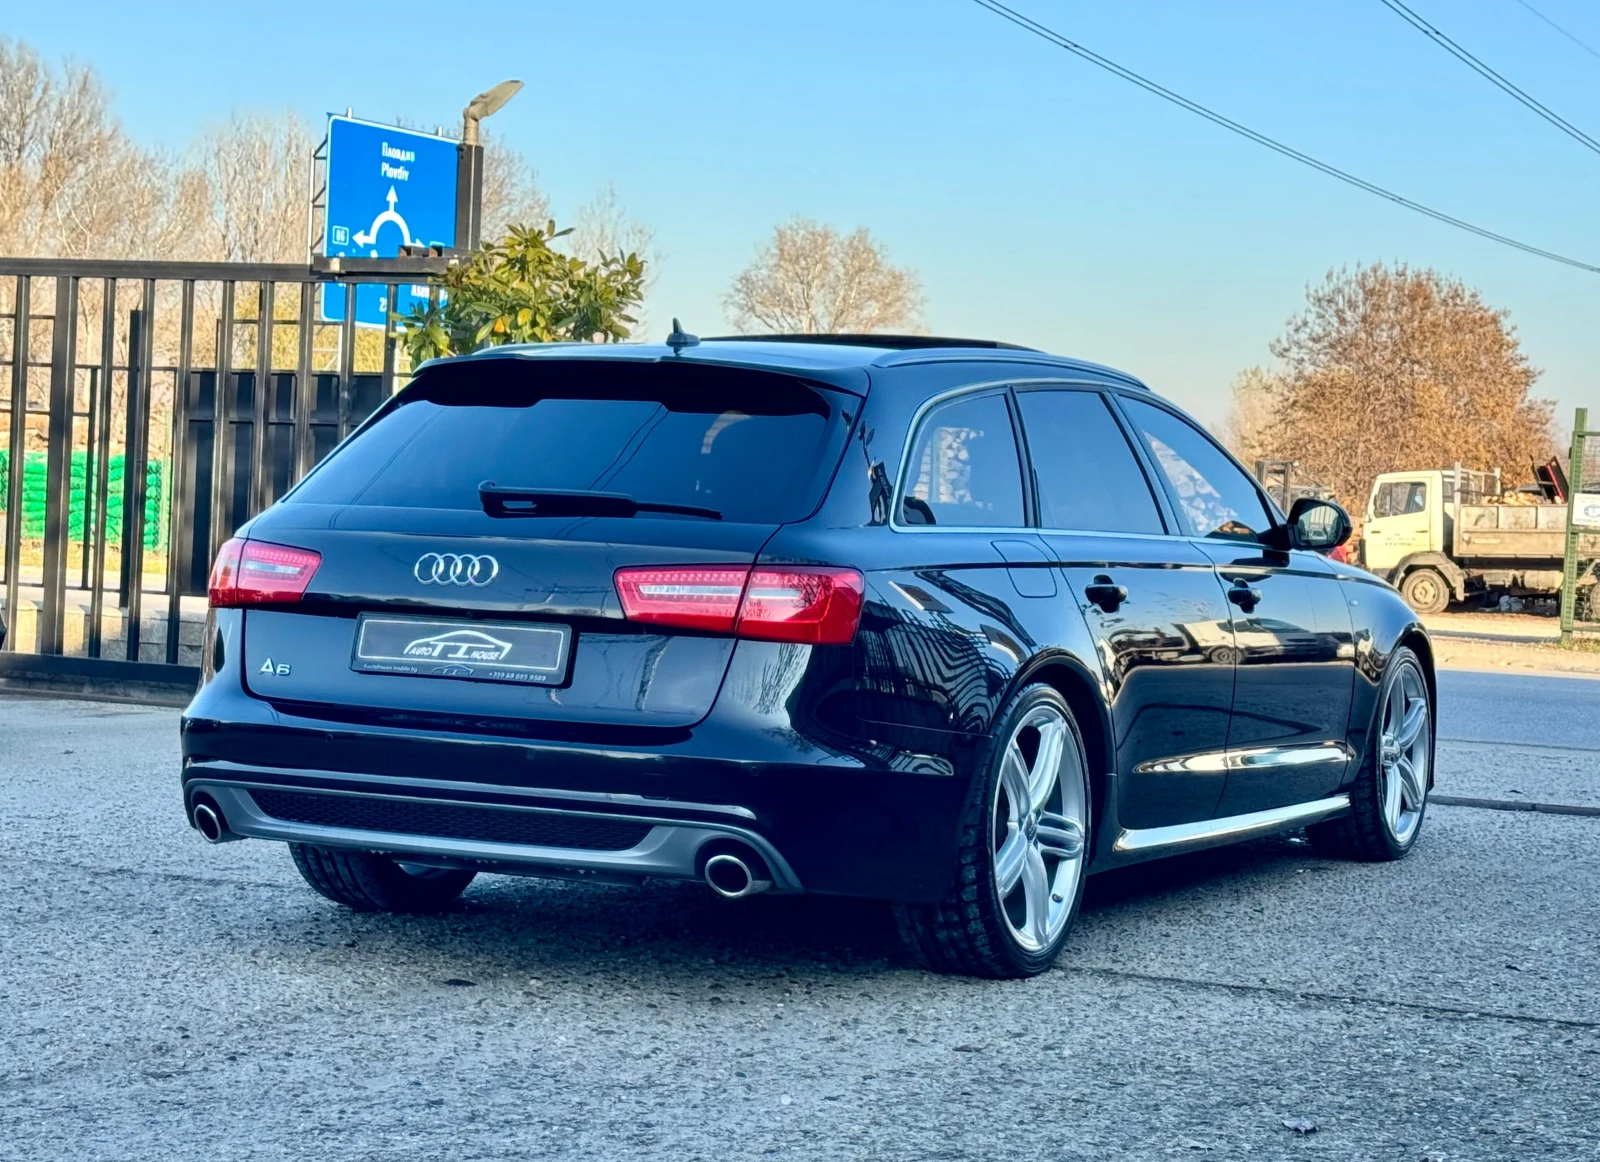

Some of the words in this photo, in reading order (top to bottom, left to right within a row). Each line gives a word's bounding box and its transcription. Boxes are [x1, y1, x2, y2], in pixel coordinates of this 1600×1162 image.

[381, 161, 410, 182] Plovdiv
[408, 646, 433, 656] AUTO
[469, 650, 501, 661] HOUSE
[259, 657, 291, 676] A6
